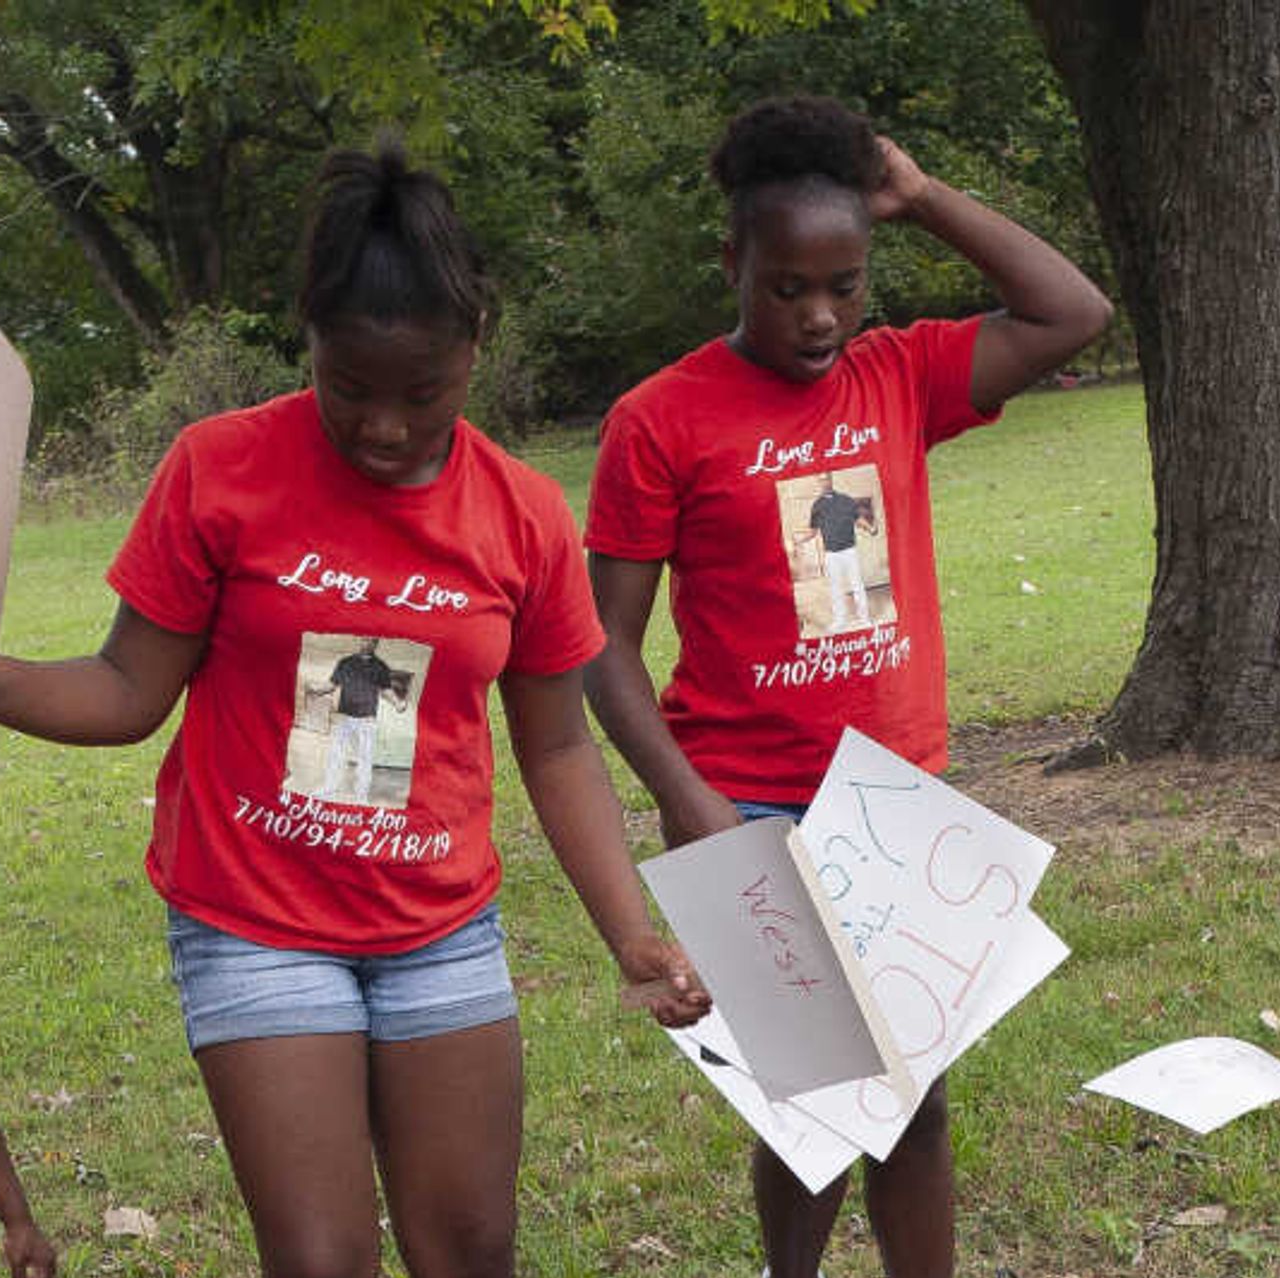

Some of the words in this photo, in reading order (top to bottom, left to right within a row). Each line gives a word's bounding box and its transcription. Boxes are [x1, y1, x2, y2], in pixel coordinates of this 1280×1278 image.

[746, 438, 814, 476] Long
[277, 553, 370, 602] Long
[386, 575, 469, 611] Live
[234, 793, 451, 861] 7/10/94-2/18/19
[741, 873, 824, 1000] West
